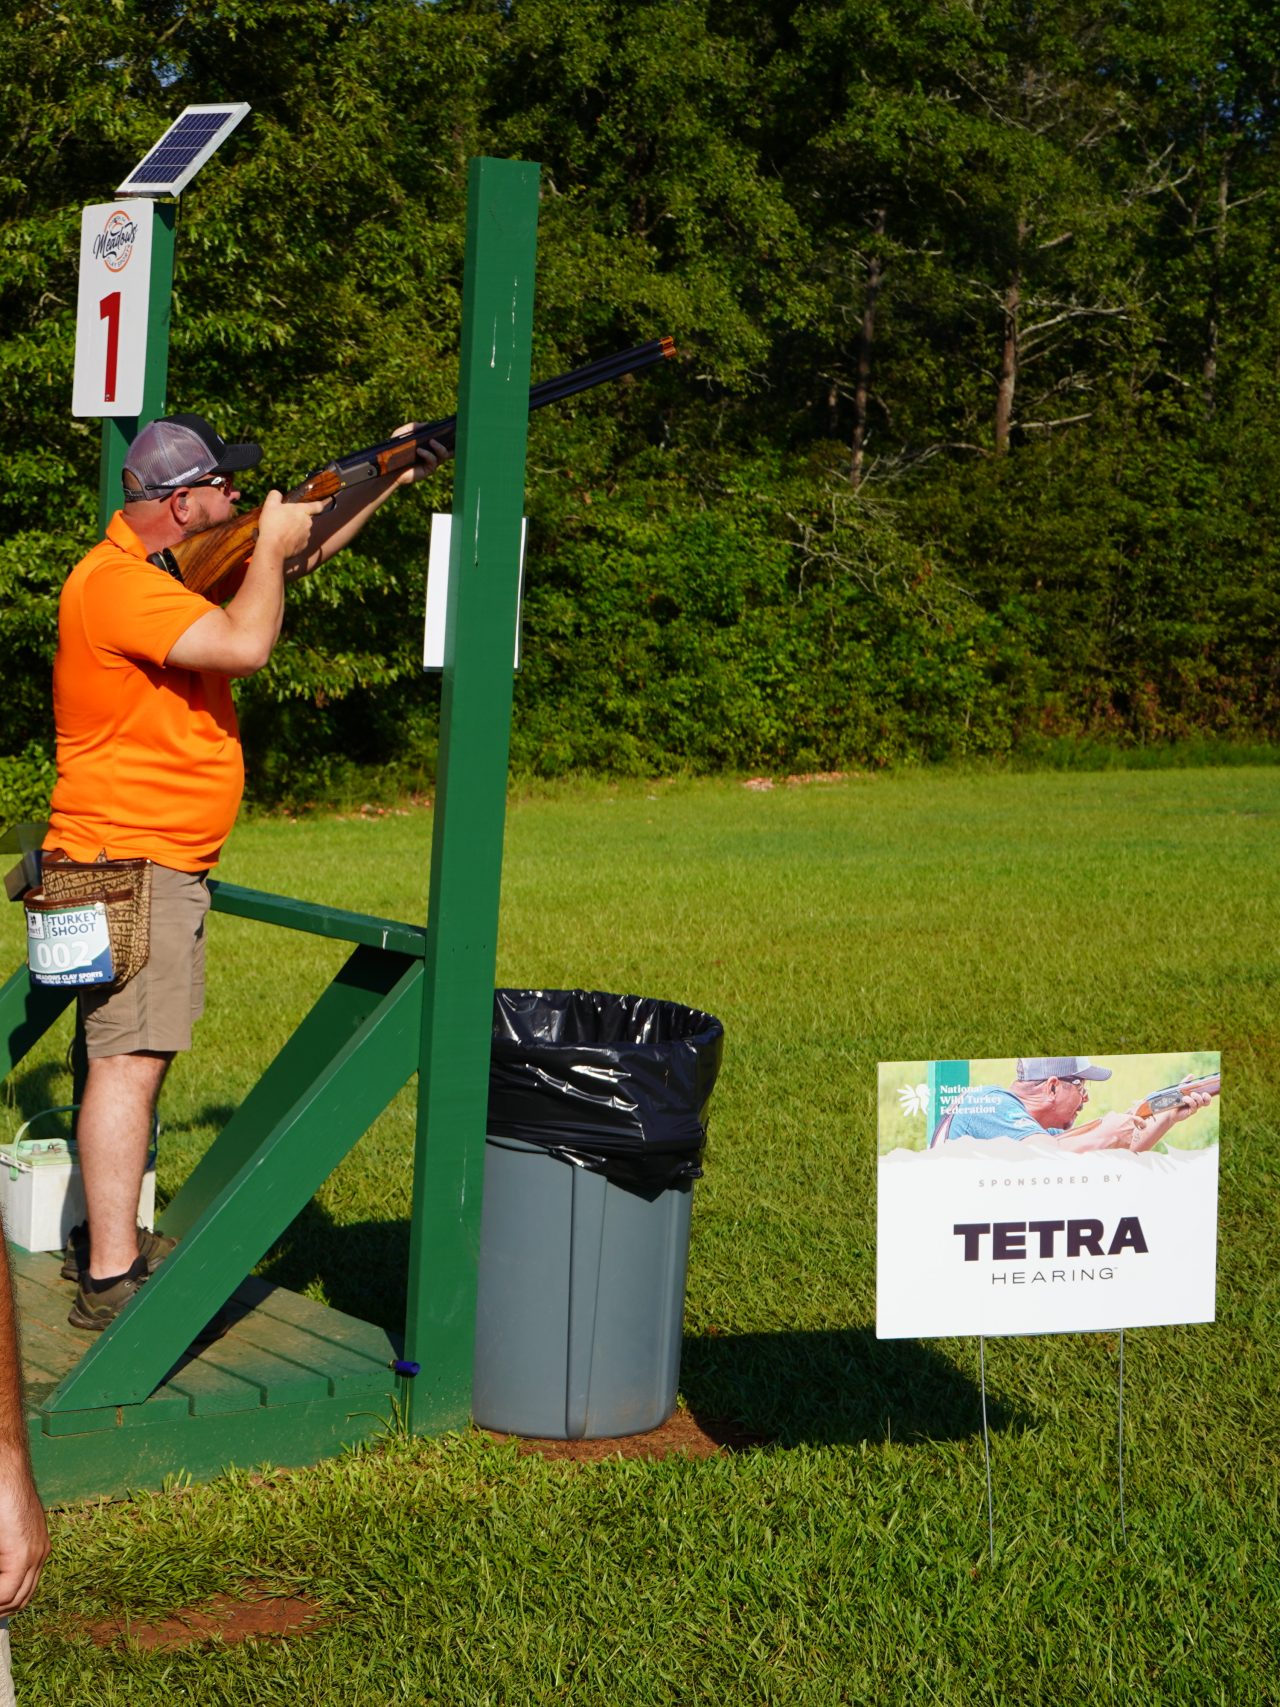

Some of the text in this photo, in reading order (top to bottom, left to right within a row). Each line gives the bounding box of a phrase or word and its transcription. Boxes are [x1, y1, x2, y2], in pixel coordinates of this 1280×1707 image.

[99, 291, 121, 402] 1
[49, 912, 97, 926] TURKEY
[51, 923, 96, 936] SHOOT
[36, 941, 92, 968] 002
[940, 1085, 983, 1094] National
[940, 1095, 964, 1105] Wild
[940, 1105, 996, 1115] Federation
[978, 1174, 1123, 1187] SPONSORED BY
[953, 1216, 1149, 1262] TETRA
[991, 1267, 1114, 1285] HEARING
